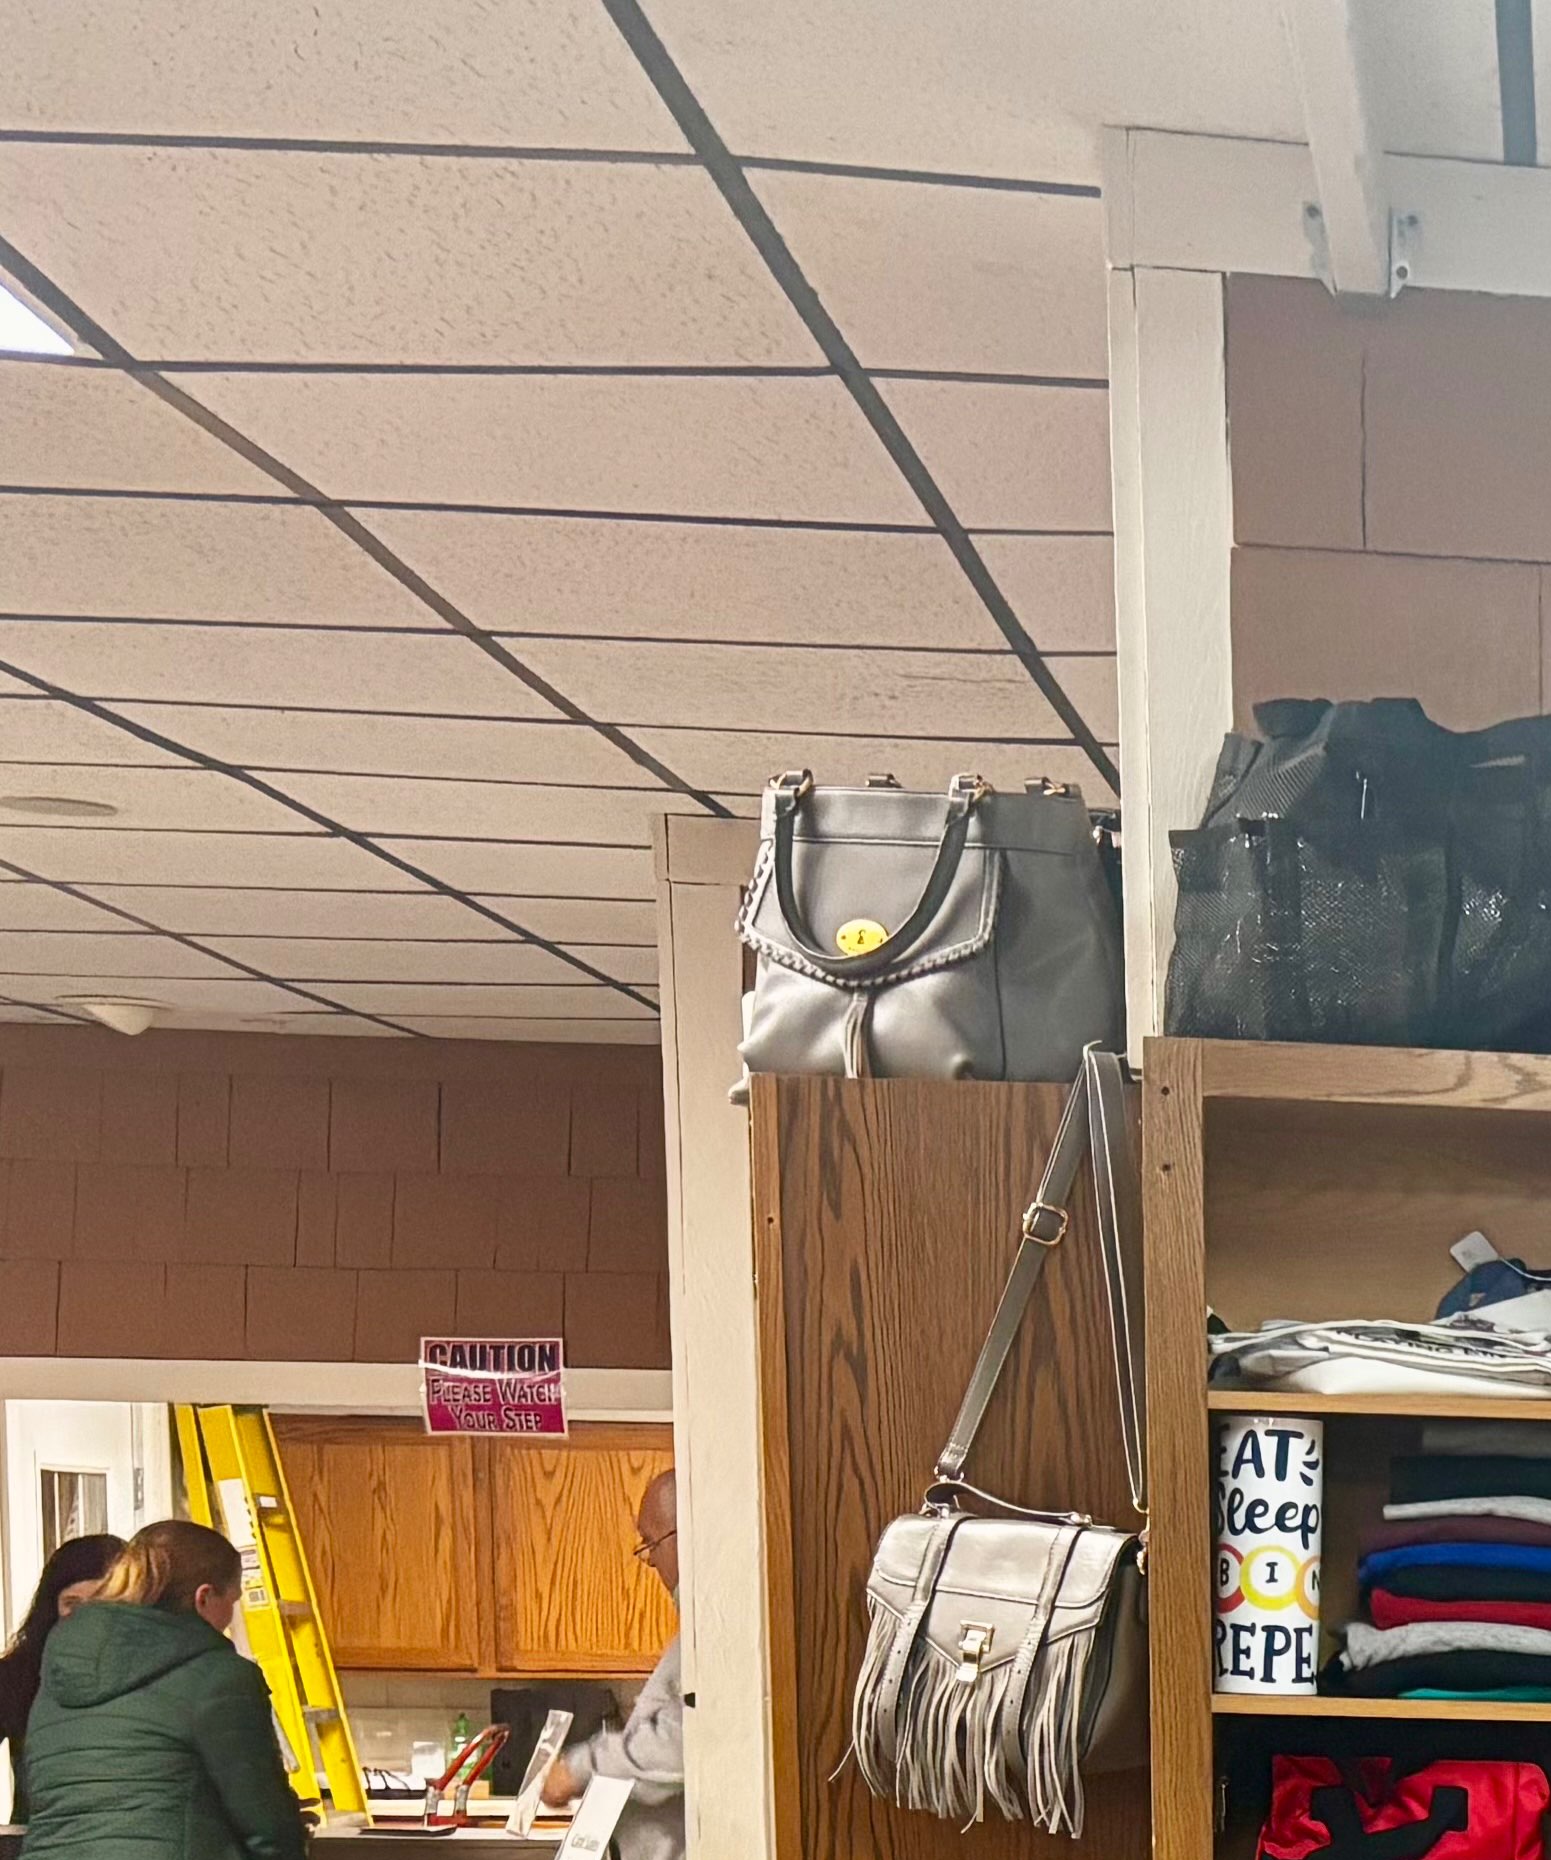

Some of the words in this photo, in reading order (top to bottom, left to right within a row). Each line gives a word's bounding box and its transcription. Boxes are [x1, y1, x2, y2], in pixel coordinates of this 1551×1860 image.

[429, 1343, 556, 1374] CAUTION
[430, 1377, 491, 1404] PLEASE
[451, 1406, 496, 1430] YOUR
[502, 1406, 542, 1430] STEP
[1216, 1622, 1315, 1686] REPE
